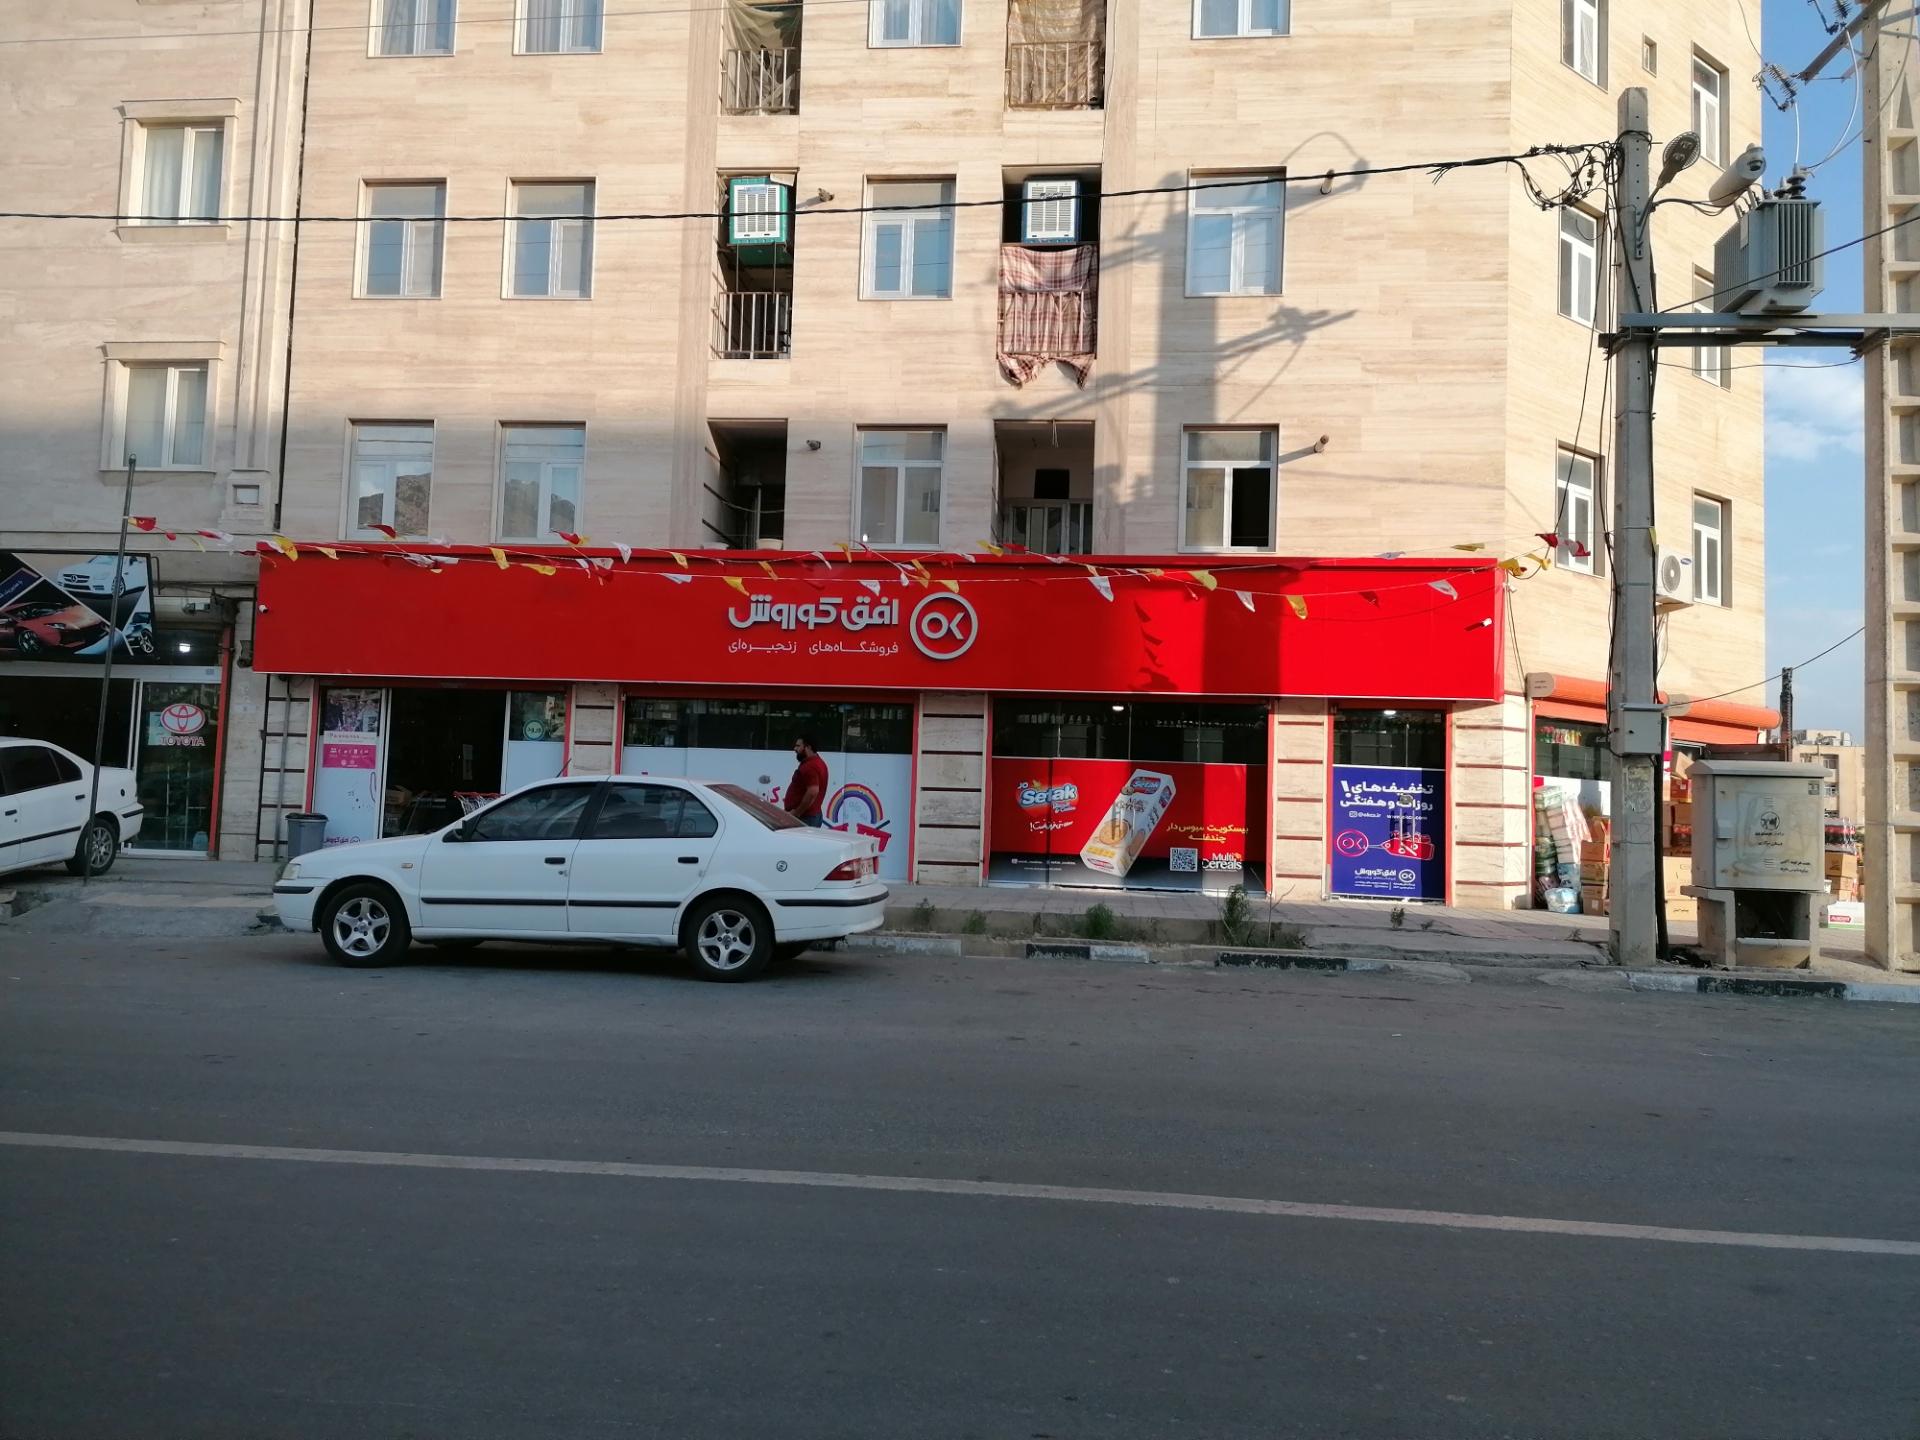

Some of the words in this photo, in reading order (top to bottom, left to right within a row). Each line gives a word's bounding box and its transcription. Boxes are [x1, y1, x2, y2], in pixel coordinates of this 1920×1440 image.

[727, 594, 843, 631] کوروش
[840, 596, 900, 632] افق
[920, 611, 967, 641] OK
[160, 735, 207, 747] TOYOTA
[1020, 783, 1078, 807] Setak
[1206, 823, 1249, 834] بیسکویت
[1187, 833, 1227, 844] چندغله
[1211, 852, 1235, 862] Multi
[1201, 858, 1244, 870] Cereals
